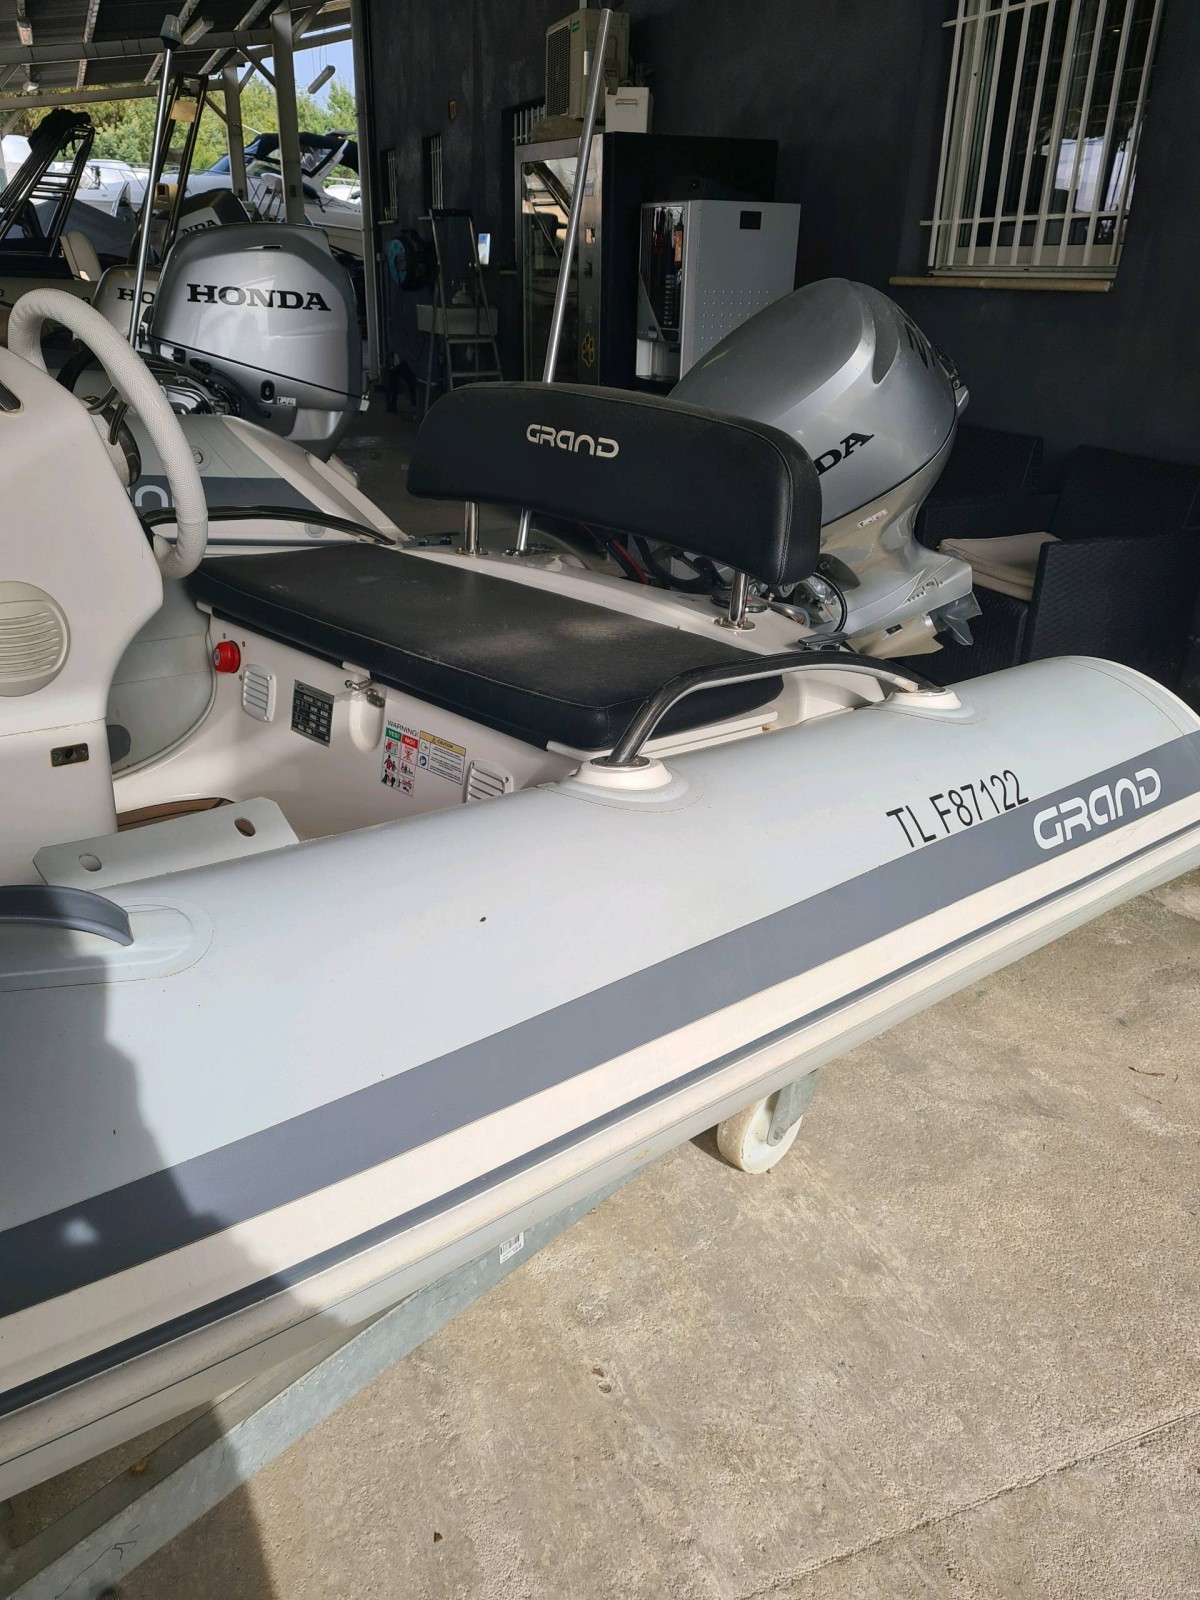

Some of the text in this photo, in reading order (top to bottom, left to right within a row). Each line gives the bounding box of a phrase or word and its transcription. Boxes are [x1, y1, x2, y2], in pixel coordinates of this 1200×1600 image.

[117, 287, 156, 305] HO
[187, 282, 331, 312] HONDA
[525, 423, 619, 459] GRAND
[813, 432, 875, 477] DA
[387, 719, 419, 738] WARNING!
[388, 729, 401, 740] YES!
[404, 737, 416, 746] NO!
[885, 768, 1030, 848] TL F87122
[1032, 766, 1162, 850] GRAND
